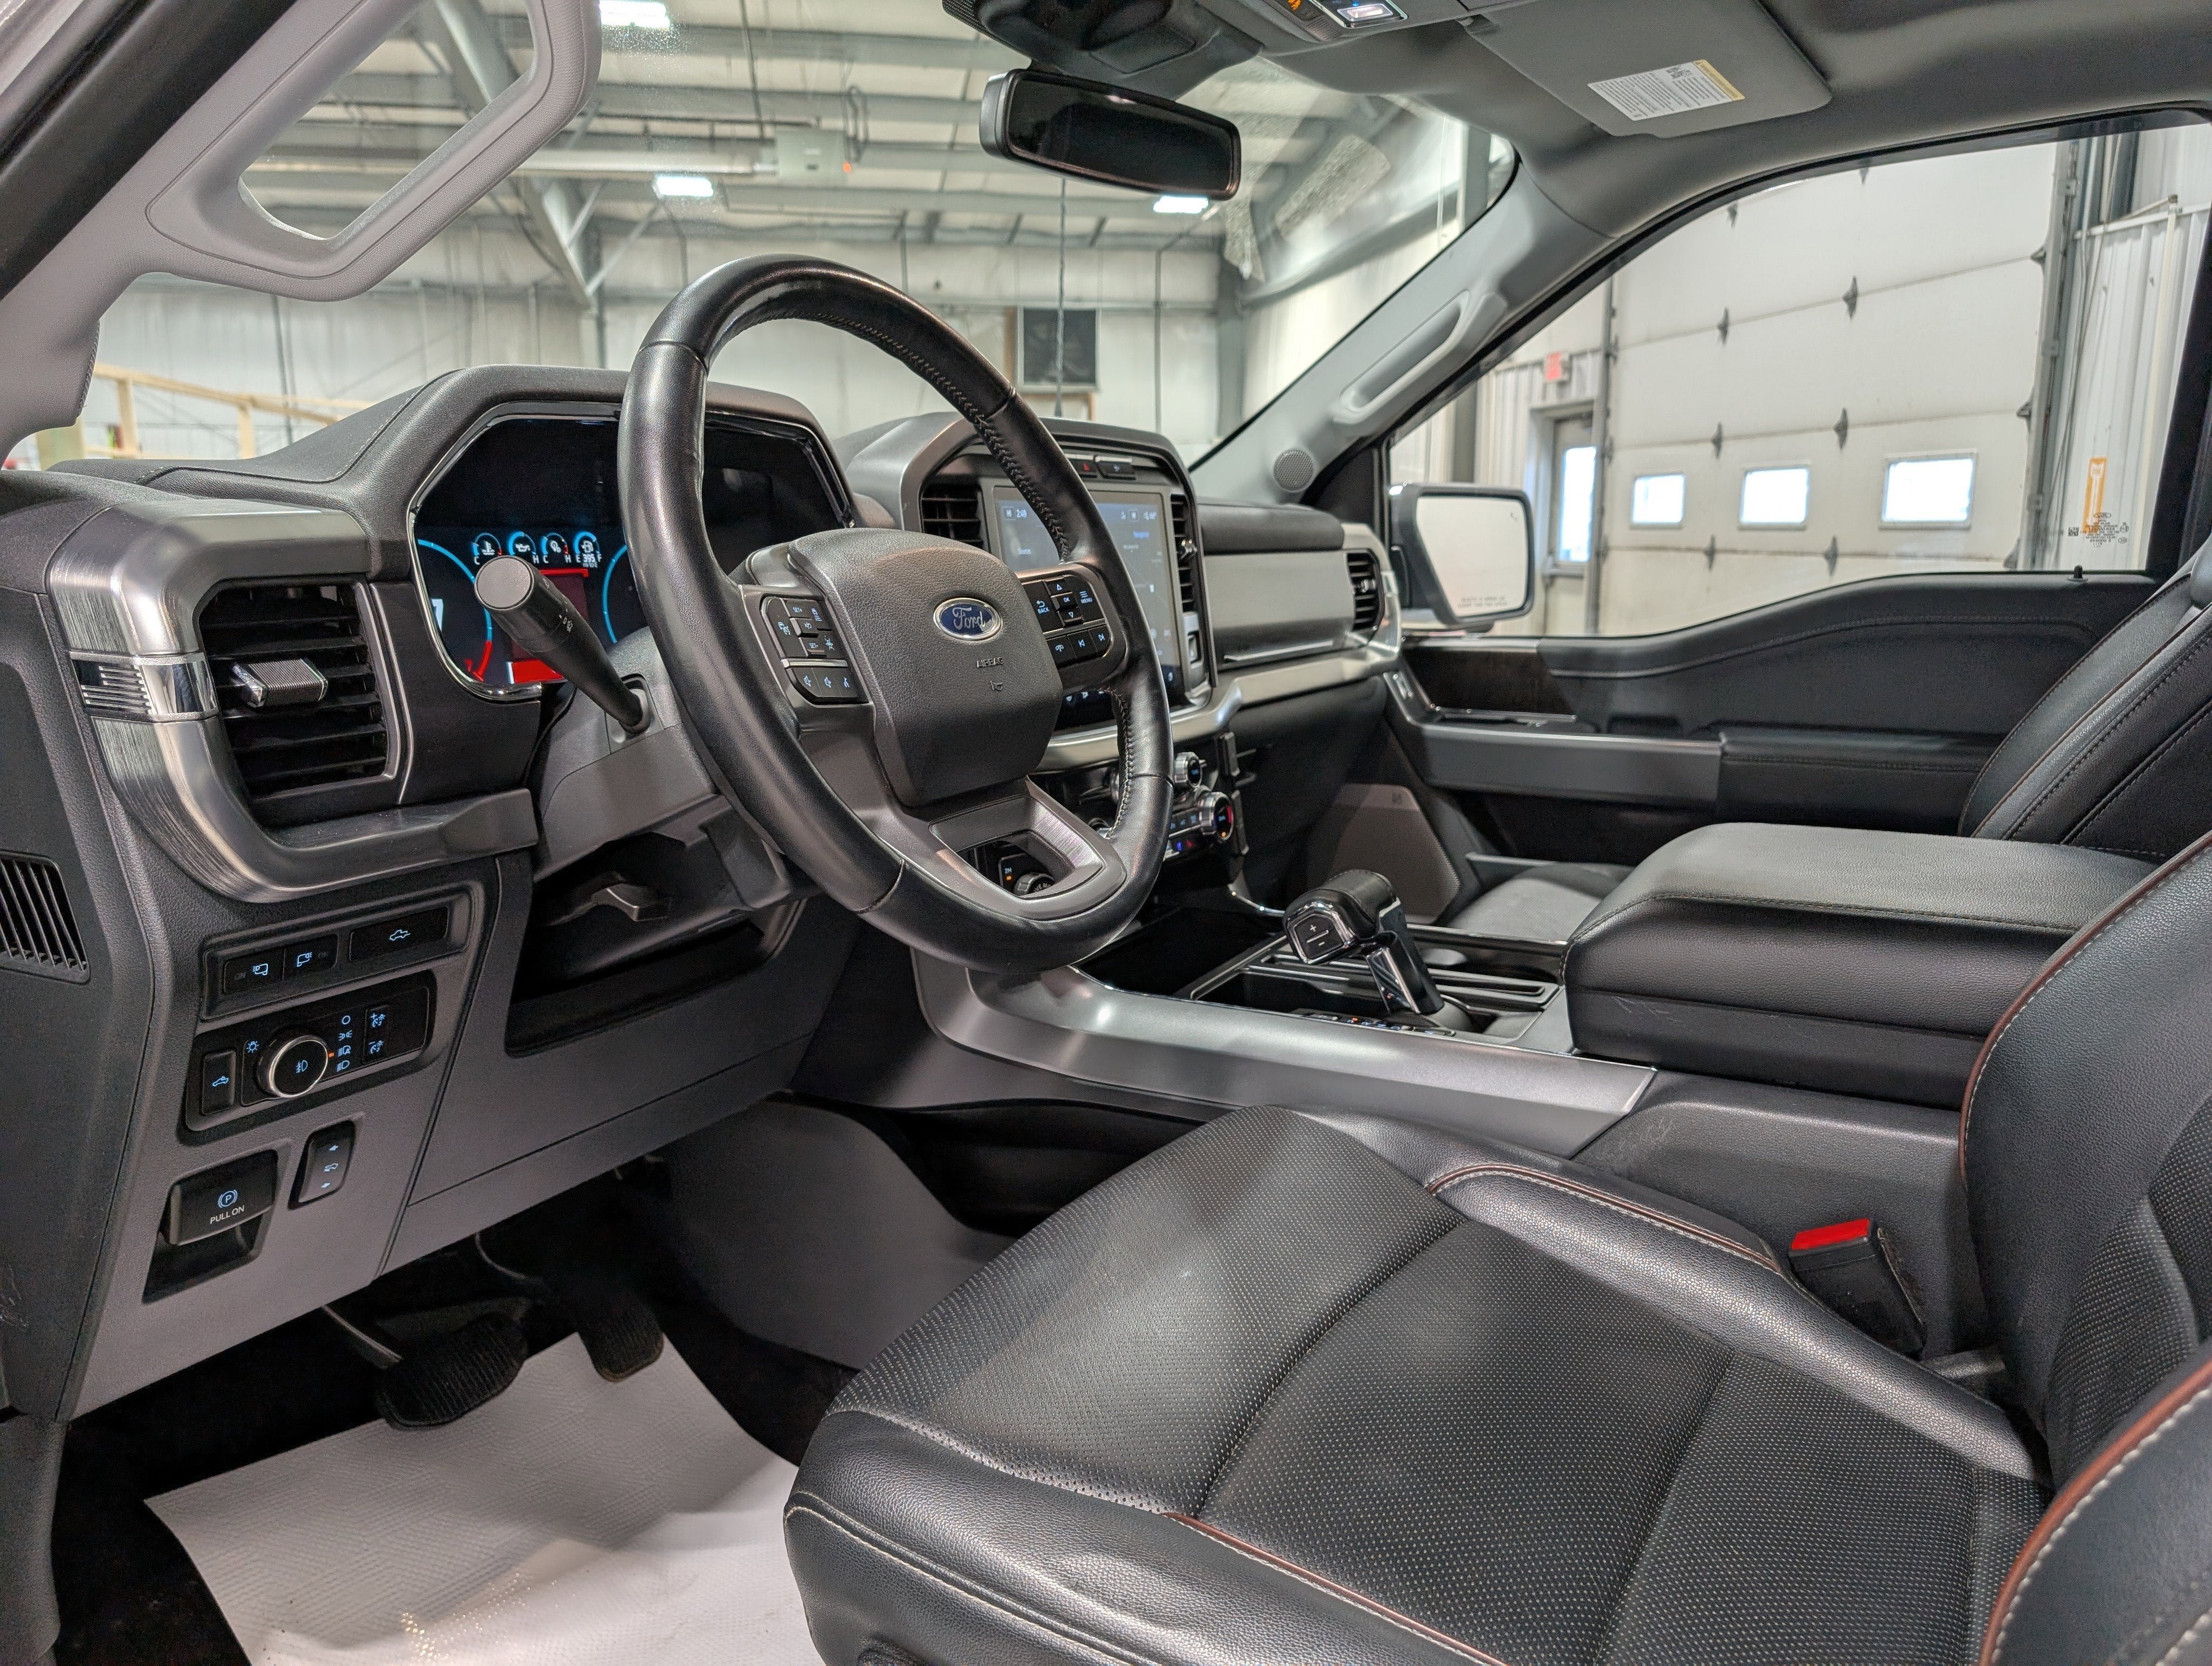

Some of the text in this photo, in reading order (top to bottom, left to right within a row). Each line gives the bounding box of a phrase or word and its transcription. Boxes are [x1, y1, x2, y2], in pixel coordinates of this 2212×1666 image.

[474, 556, 480, 565] C
[532, 555, 539, 564] H
[543, 554, 571, 563] C H
[576, 553, 602, 563] E 395 F
[952, 607, 986, 630] Ford
[976, 657, 1004, 668] AIRBAG
[225, 1194, 232, 1203] P
[210, 1204, 245, 1225] PULL ON
